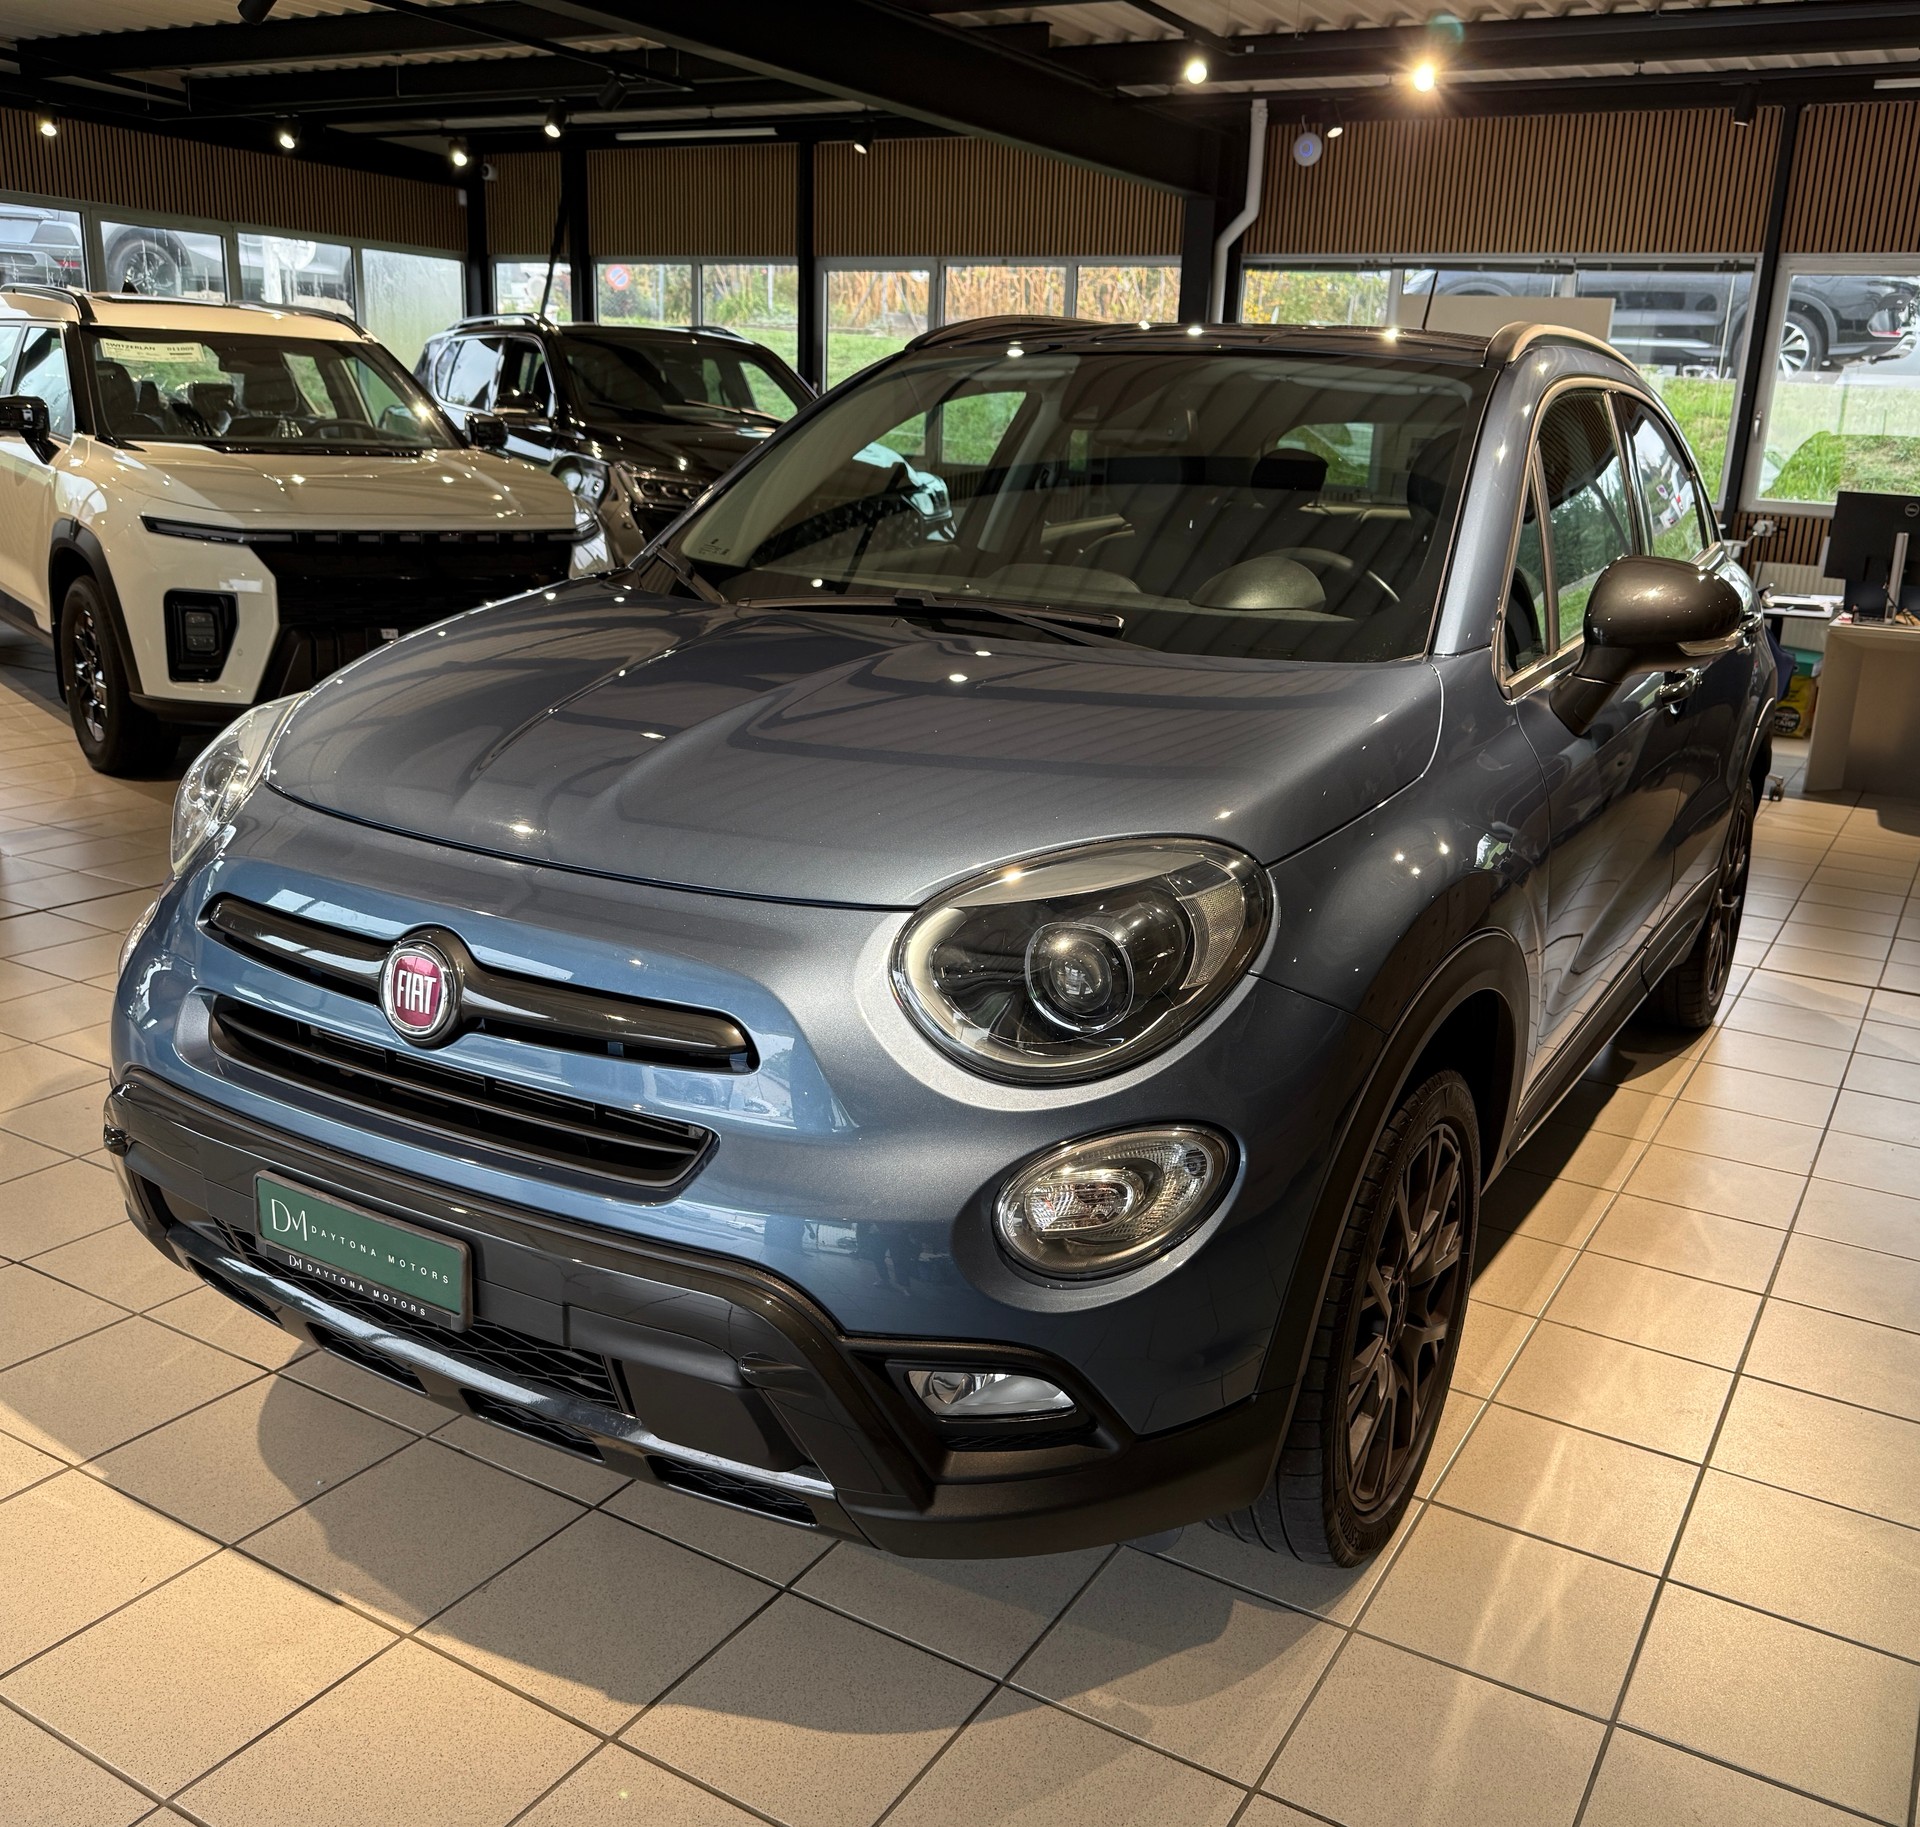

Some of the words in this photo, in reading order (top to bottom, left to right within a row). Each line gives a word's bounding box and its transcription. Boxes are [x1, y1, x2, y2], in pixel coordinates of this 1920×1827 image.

[396, 969, 437, 1015] FIAT
[311, 1225, 377, 1257] DAYTONA
[388, 1254, 449, 1284] MOTORS
[307, 1264, 364, 1292] DAYTONA
[373, 1289, 426, 1316] MOTORS
